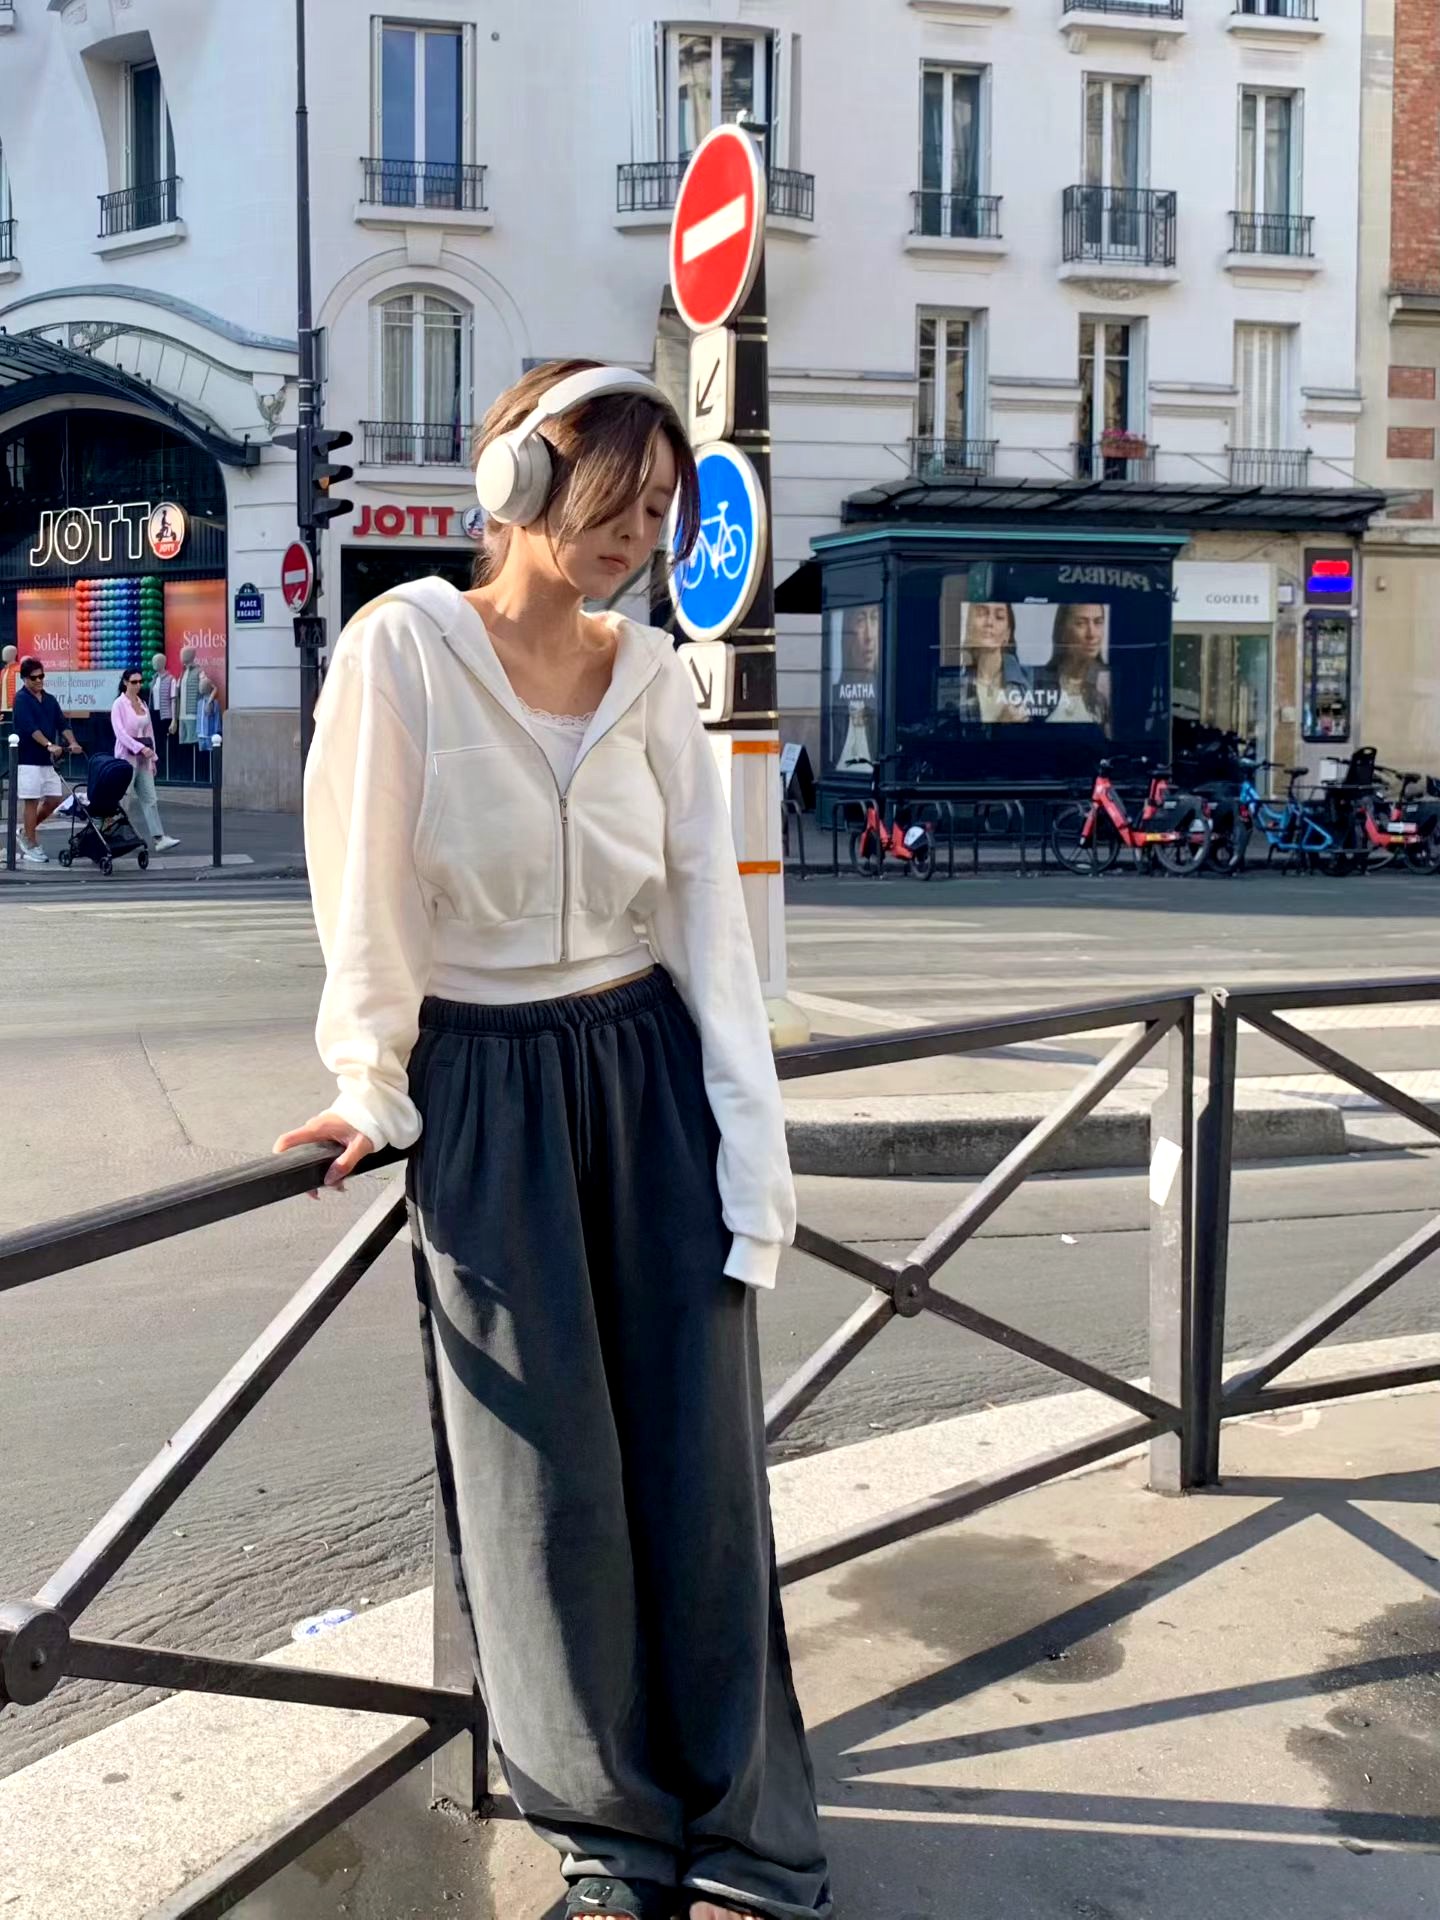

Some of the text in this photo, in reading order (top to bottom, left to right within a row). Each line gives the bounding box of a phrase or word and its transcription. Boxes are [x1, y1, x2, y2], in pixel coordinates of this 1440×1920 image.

[353, 505, 455, 538] JOTT
[30, 502, 150, 567] JOTT
[239, 600, 257, 608] PLACE
[1205, 594, 1259, 604] COOKIES
[33, 633, 71, 652] Soldes
[183, 628, 226, 649] Soldes
[840, 684, 876, 698] AGATHA
[996, 688, 1071, 705] AGATHA
